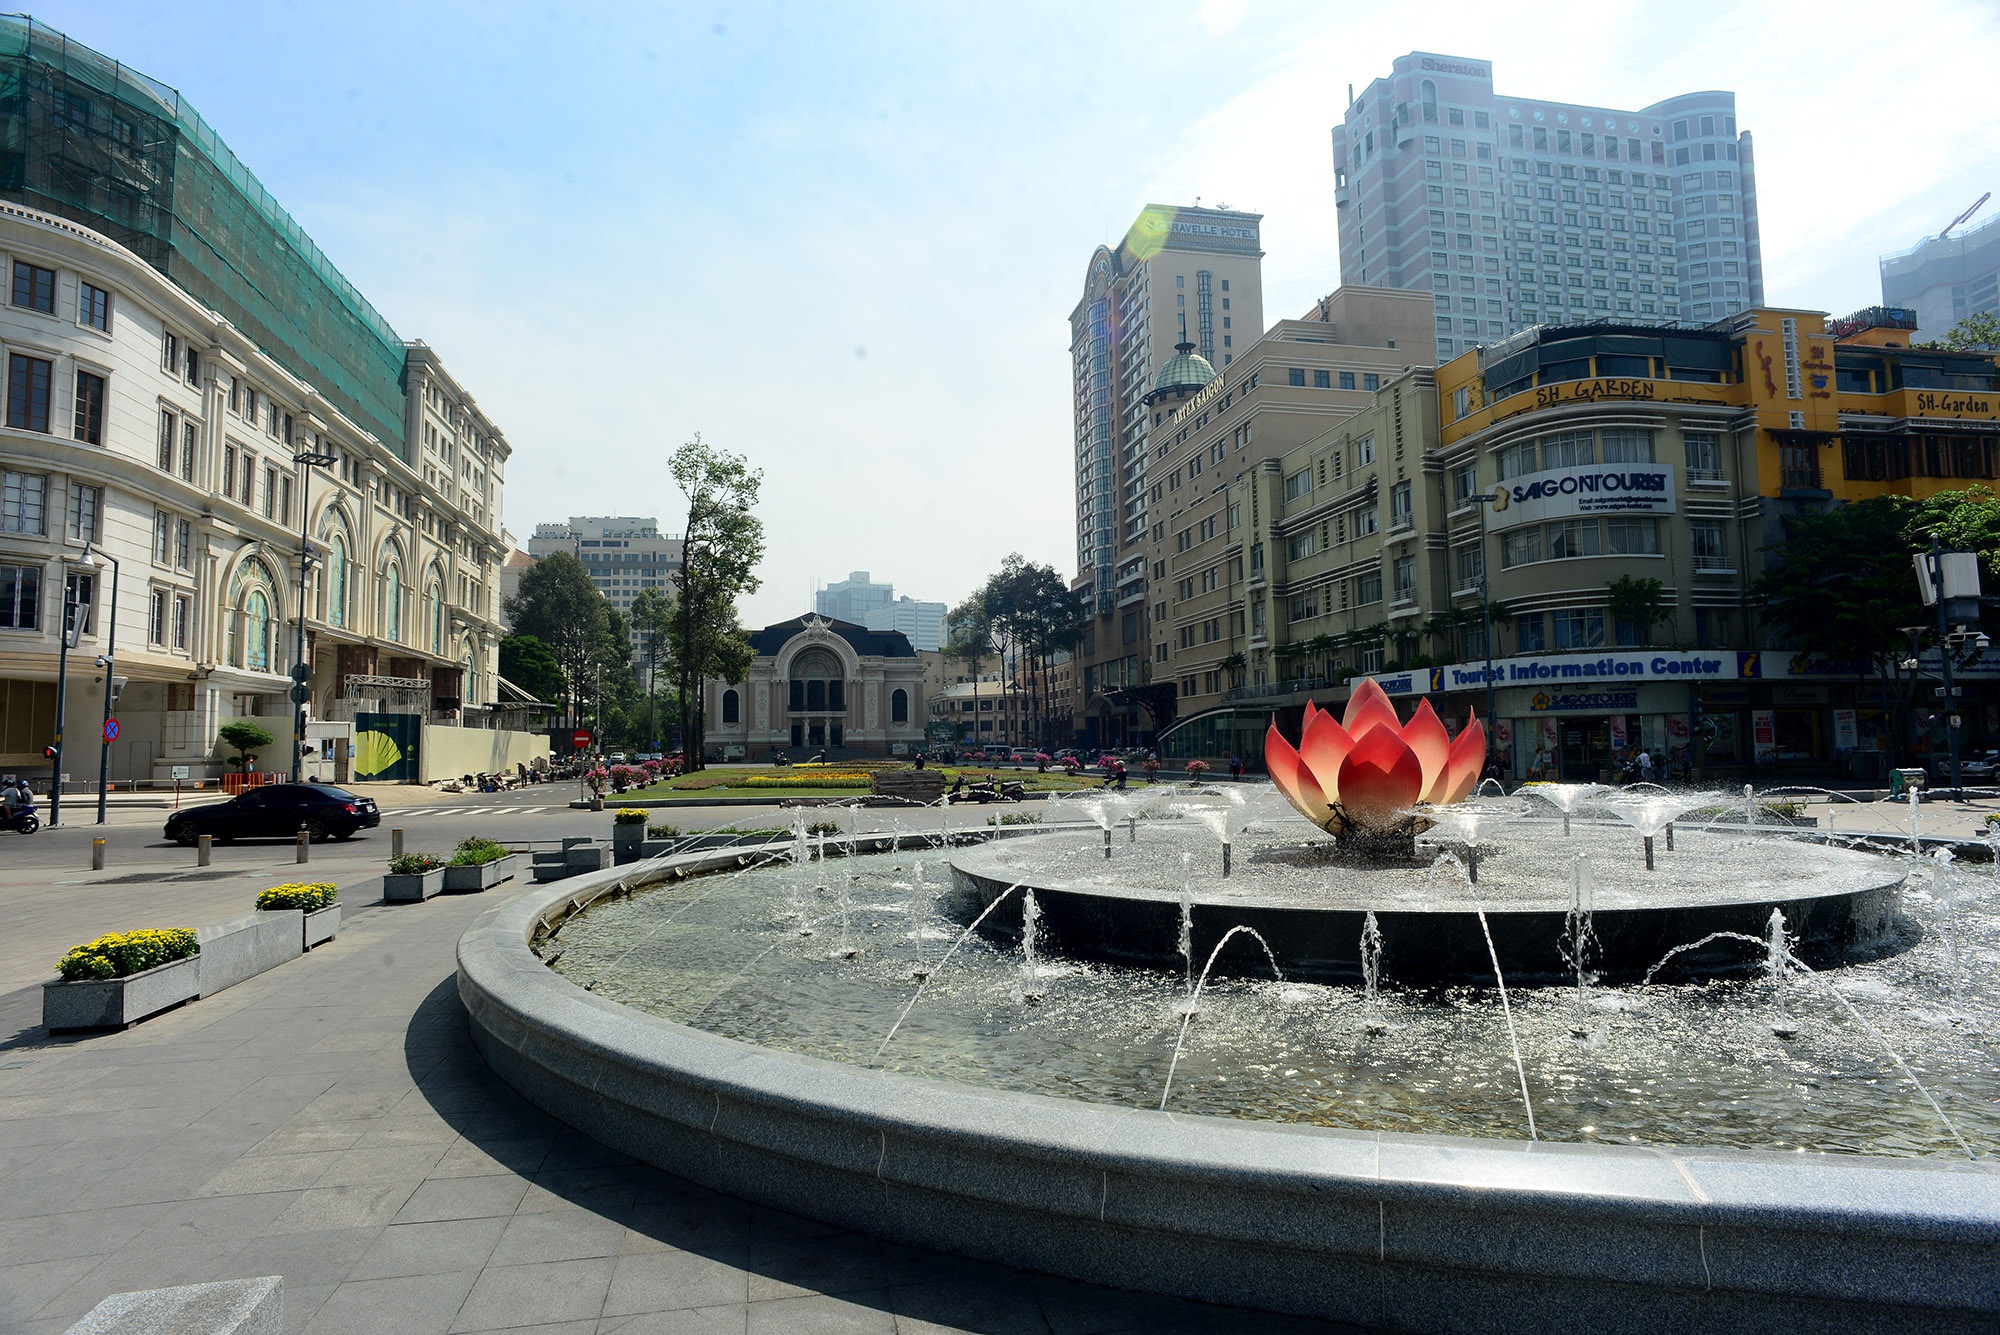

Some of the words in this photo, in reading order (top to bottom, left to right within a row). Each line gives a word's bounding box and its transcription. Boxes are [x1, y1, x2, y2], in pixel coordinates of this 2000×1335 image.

[1421, 57, 1487, 78] Sheraton
[1158, 221, 1218, 236] CARAVELLE
[1221, 227, 1256, 239] HOTEL
[1174, 397, 1197, 427] ARTEX
[1196, 373, 1226, 408] SAIGON
[1536, 386, 1560, 404] SH
[1574, 380, 1655, 398] GARDEN
[1512, 473, 1668, 503] SAIGONTOURIST
[1452, 664, 1505, 685] Tourist
[1510, 657, 1644, 680] Information
[1651, 657, 1722, 674] Center
